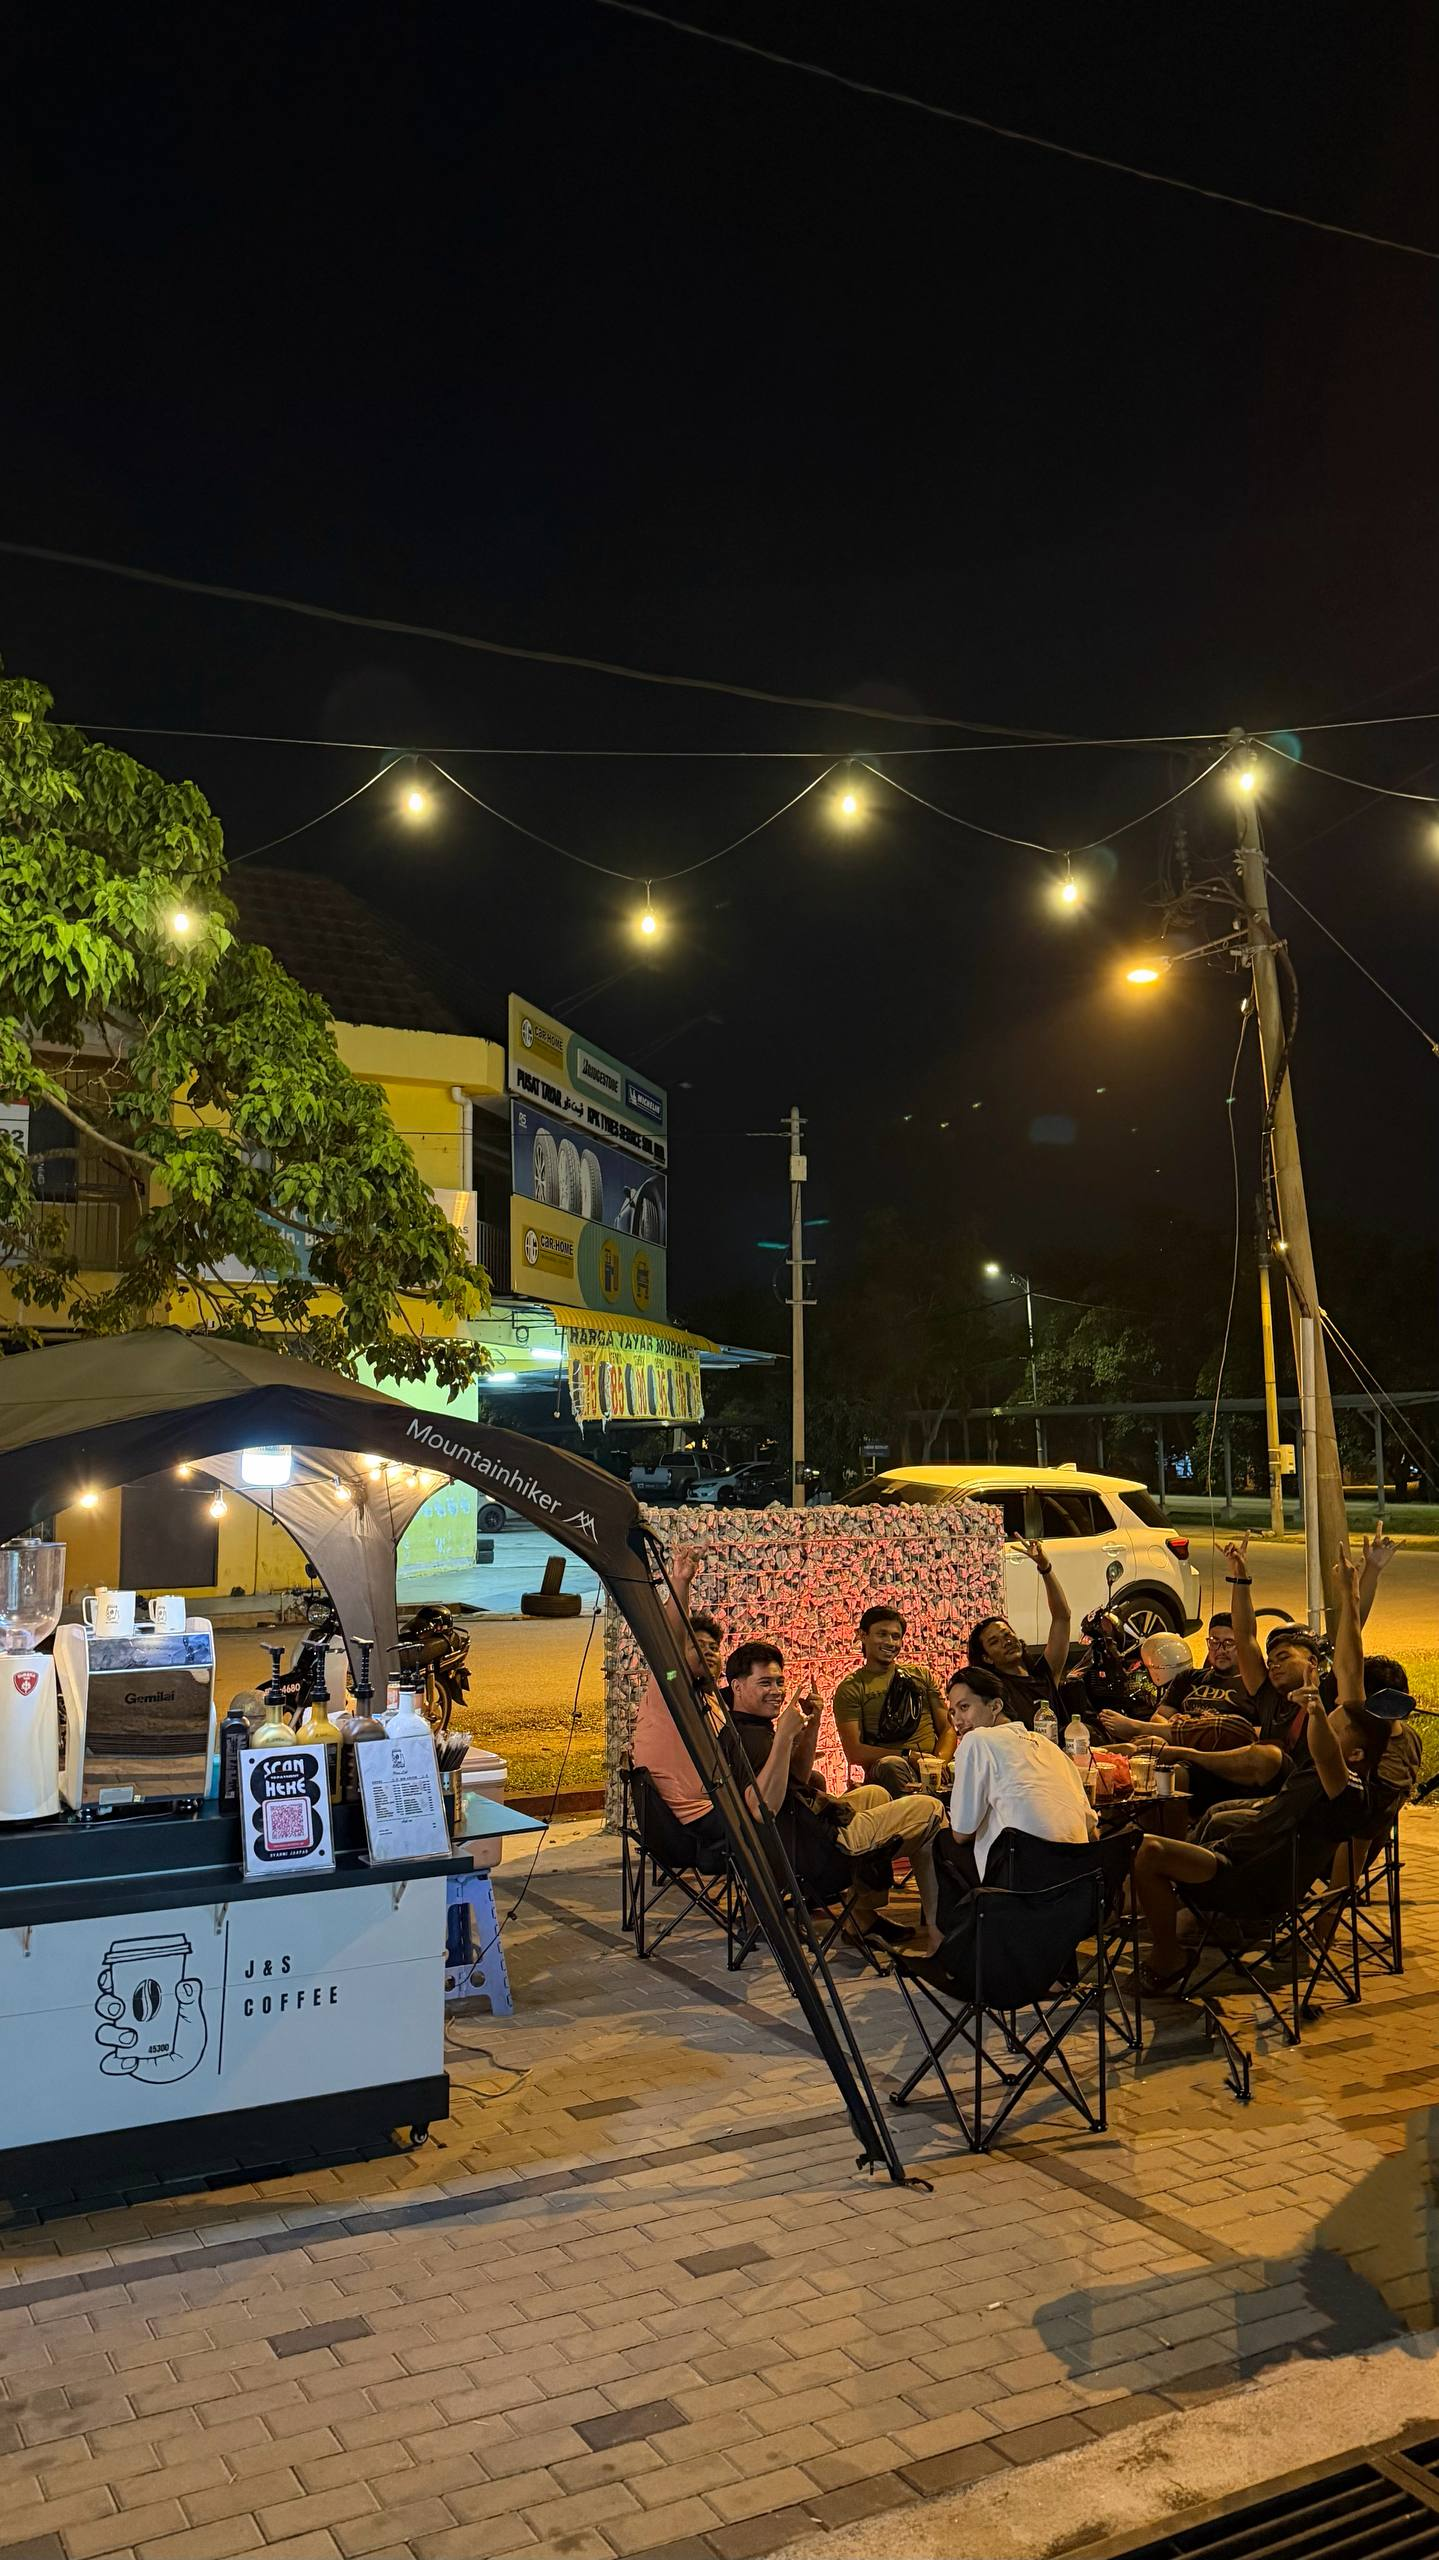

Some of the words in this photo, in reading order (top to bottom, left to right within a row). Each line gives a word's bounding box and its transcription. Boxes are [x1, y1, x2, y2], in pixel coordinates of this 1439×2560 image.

[517, 1068, 540, 1096] PUSAT
[570, 1326, 614, 1347] HARGA
[619, 1332, 653, 1351] TAYAR
[406, 1418, 562, 1514] Mountainhiker
[125, 1690, 175, 1704] Gemilai
[263, 1759, 305, 1778] SCAN
[265, 1778, 306, 1797] HERE
[244, 1986, 337, 2016] COFFEE
[148, 2042, 170, 2053] 45300
